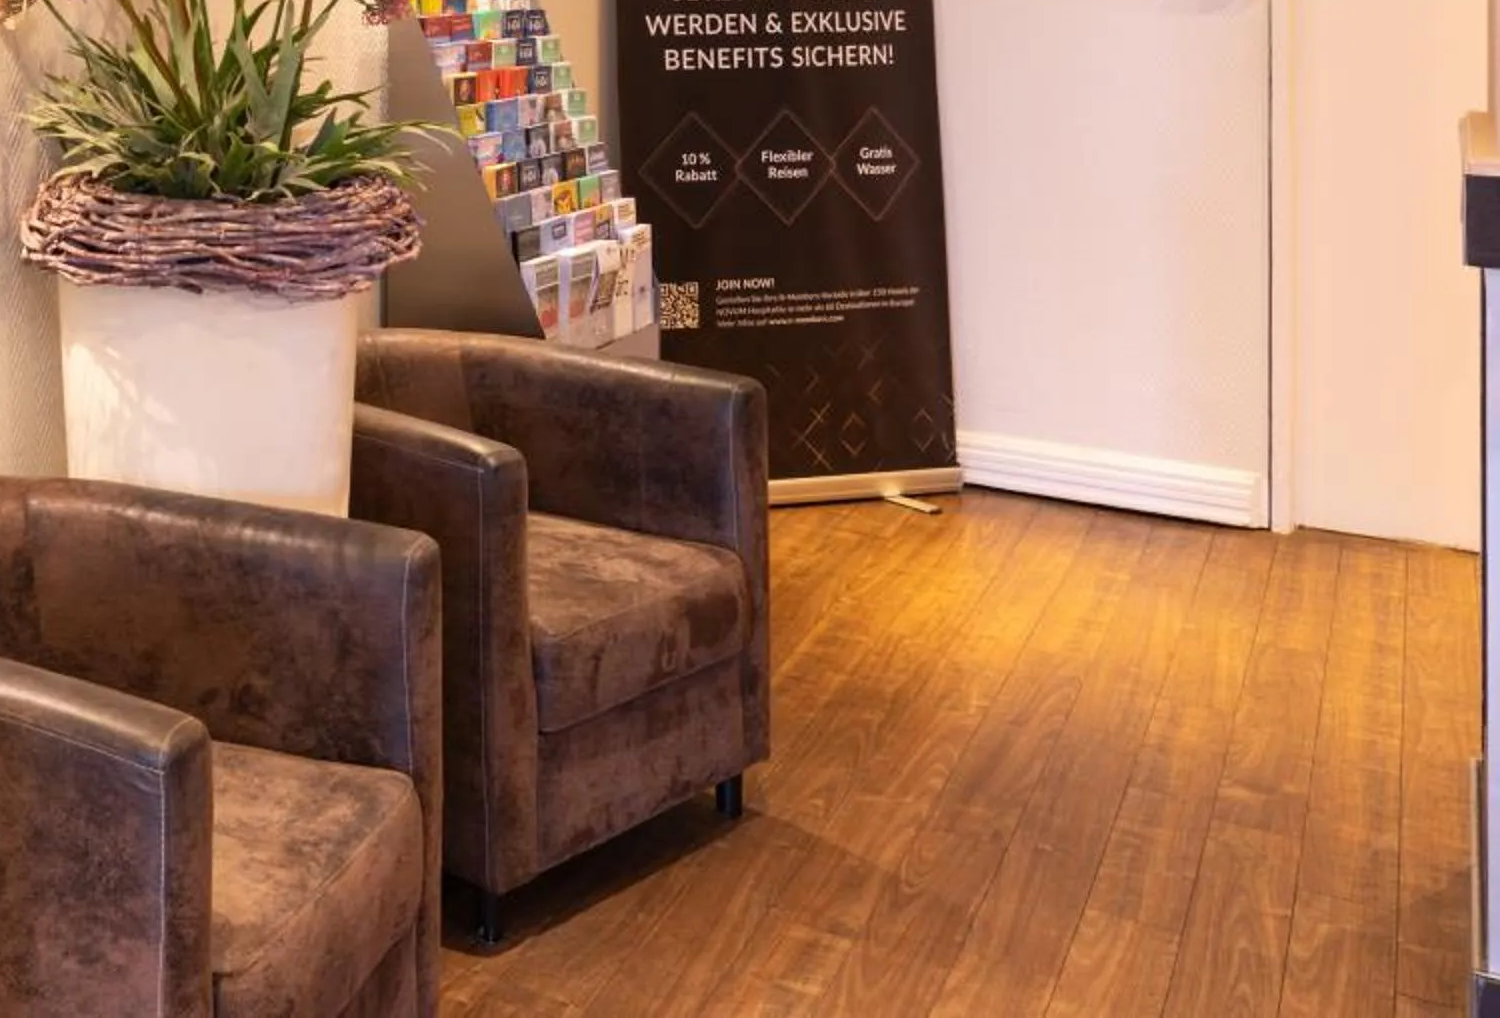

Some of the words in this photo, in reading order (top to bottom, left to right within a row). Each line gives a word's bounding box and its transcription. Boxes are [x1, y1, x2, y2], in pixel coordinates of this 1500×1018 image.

[644, 12, 758, 37] WERDEN
[764, 12, 783, 34] &
[790, 9, 908, 34] EXKLUSIVE
[664, 46, 784, 71] BENEFITS
[791, 44, 895, 68] SICHERN!
[681, 152, 697, 166] 10
[699, 152, 712, 166] %
[760, 149, 815, 164] Flexibler
[859, 146, 893, 160] Gratis
[674, 169, 718, 182] Rabatt
[767, 166, 809, 179] Reisen
[856, 162, 898, 176] Wasser
[715, 279, 741, 291] JOIN
[743, 278, 776, 290] NOW!
